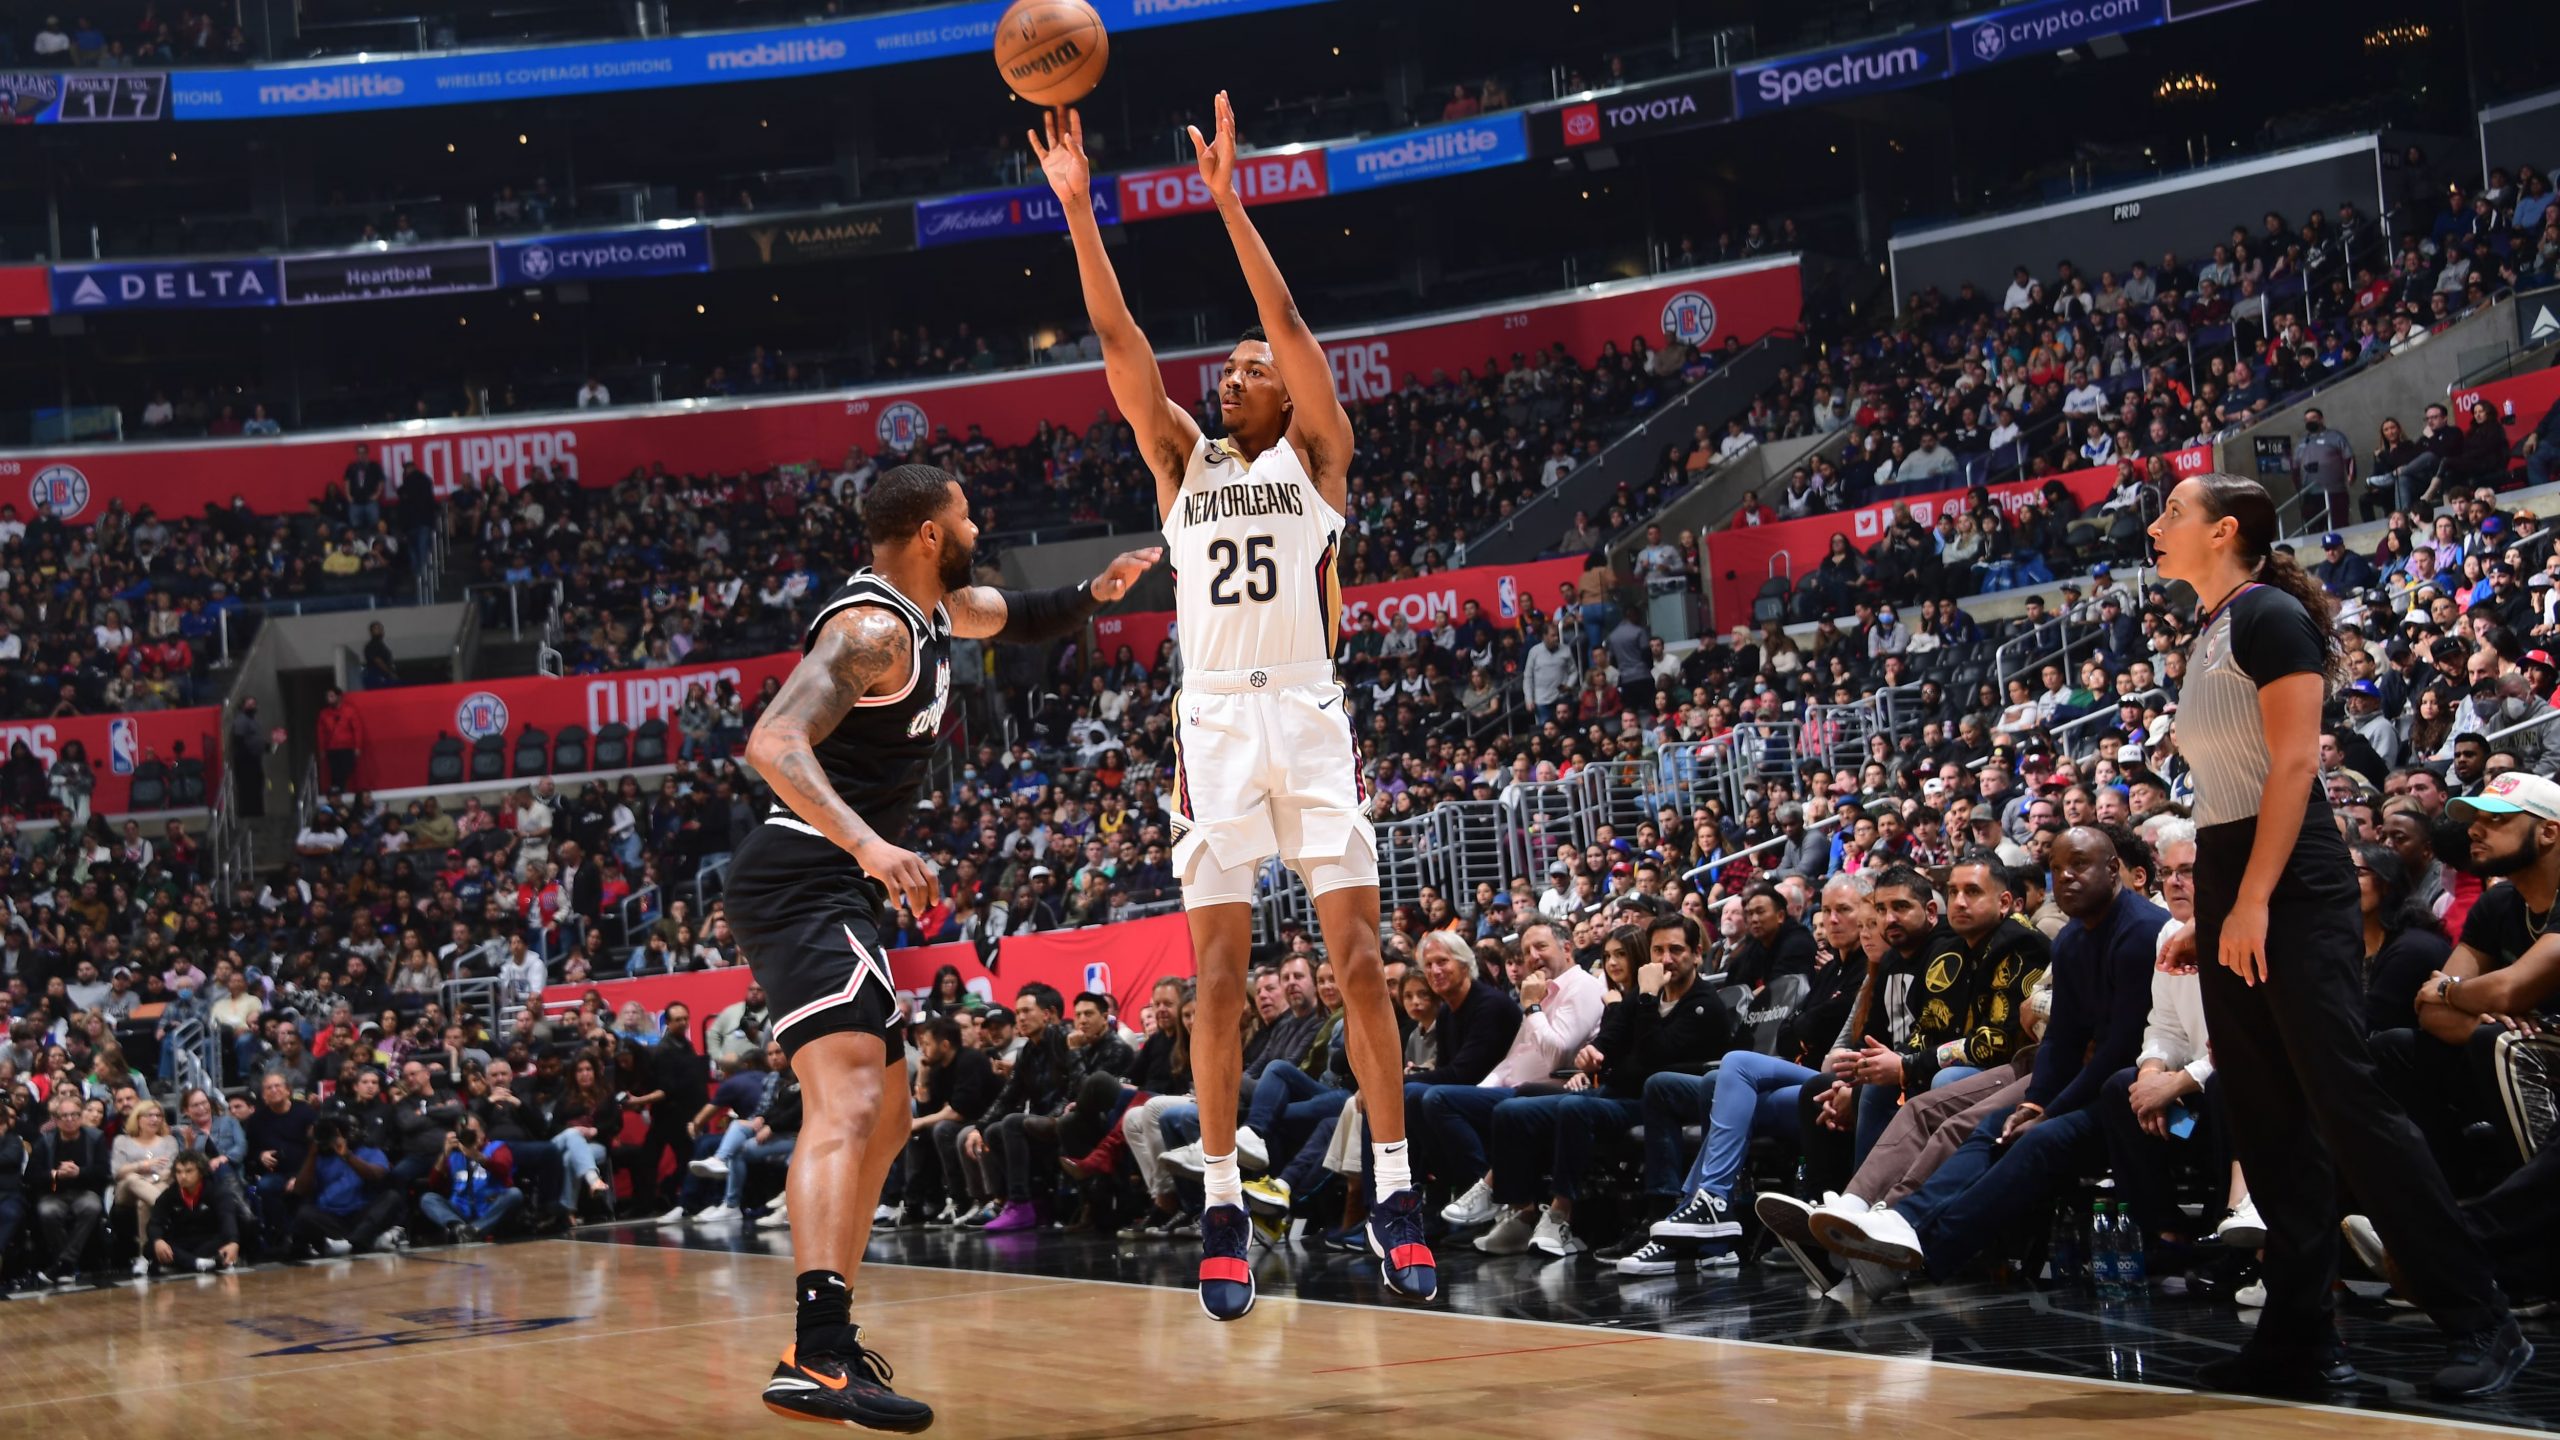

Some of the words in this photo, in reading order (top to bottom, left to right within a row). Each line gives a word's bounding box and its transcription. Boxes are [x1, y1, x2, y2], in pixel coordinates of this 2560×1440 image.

[876, 31, 937, 50] WIRELESS
[941, 21, 997, 42] COVER
[2010, 0, 2139, 42] crypto.com
[708, 38, 846, 70] mobilitie
[1010, 40, 1082, 79] Wilson
[127, 79, 150, 90] TOL
[437, 71, 500, 89] WIRELESS
[506, 64, 589, 84] COVERAGE
[593, 58, 674, 78] SOLUTIONS
[1758, 47, 1919, 103] Spectrum
[173, 90, 223, 105] TIONS
[259, 74, 405, 105] mobilitie
[83, 93, 96, 117] 1
[131, 93, 147, 117] 7
[1606, 97, 1697, 128] TOYOTA
[1356, 129, 1498, 174] mobilitie
[1026, 193, 1109, 221] ULA
[2114, 202, 2140, 221] PR10
[558, 240, 687, 269] crypto.com
[121, 270, 264, 300] DELTA
[346, 265, 432, 286] Heartbeat
[1504, 314, 1528, 330] 210
[2175, 451, 2202, 471] 108
[1184, 490, 1218, 529] NEW
[1219, 482, 1303, 518] ORLEANS
[1208, 534, 1278, 606] 25
[1099, 620, 1122, 635] 108
